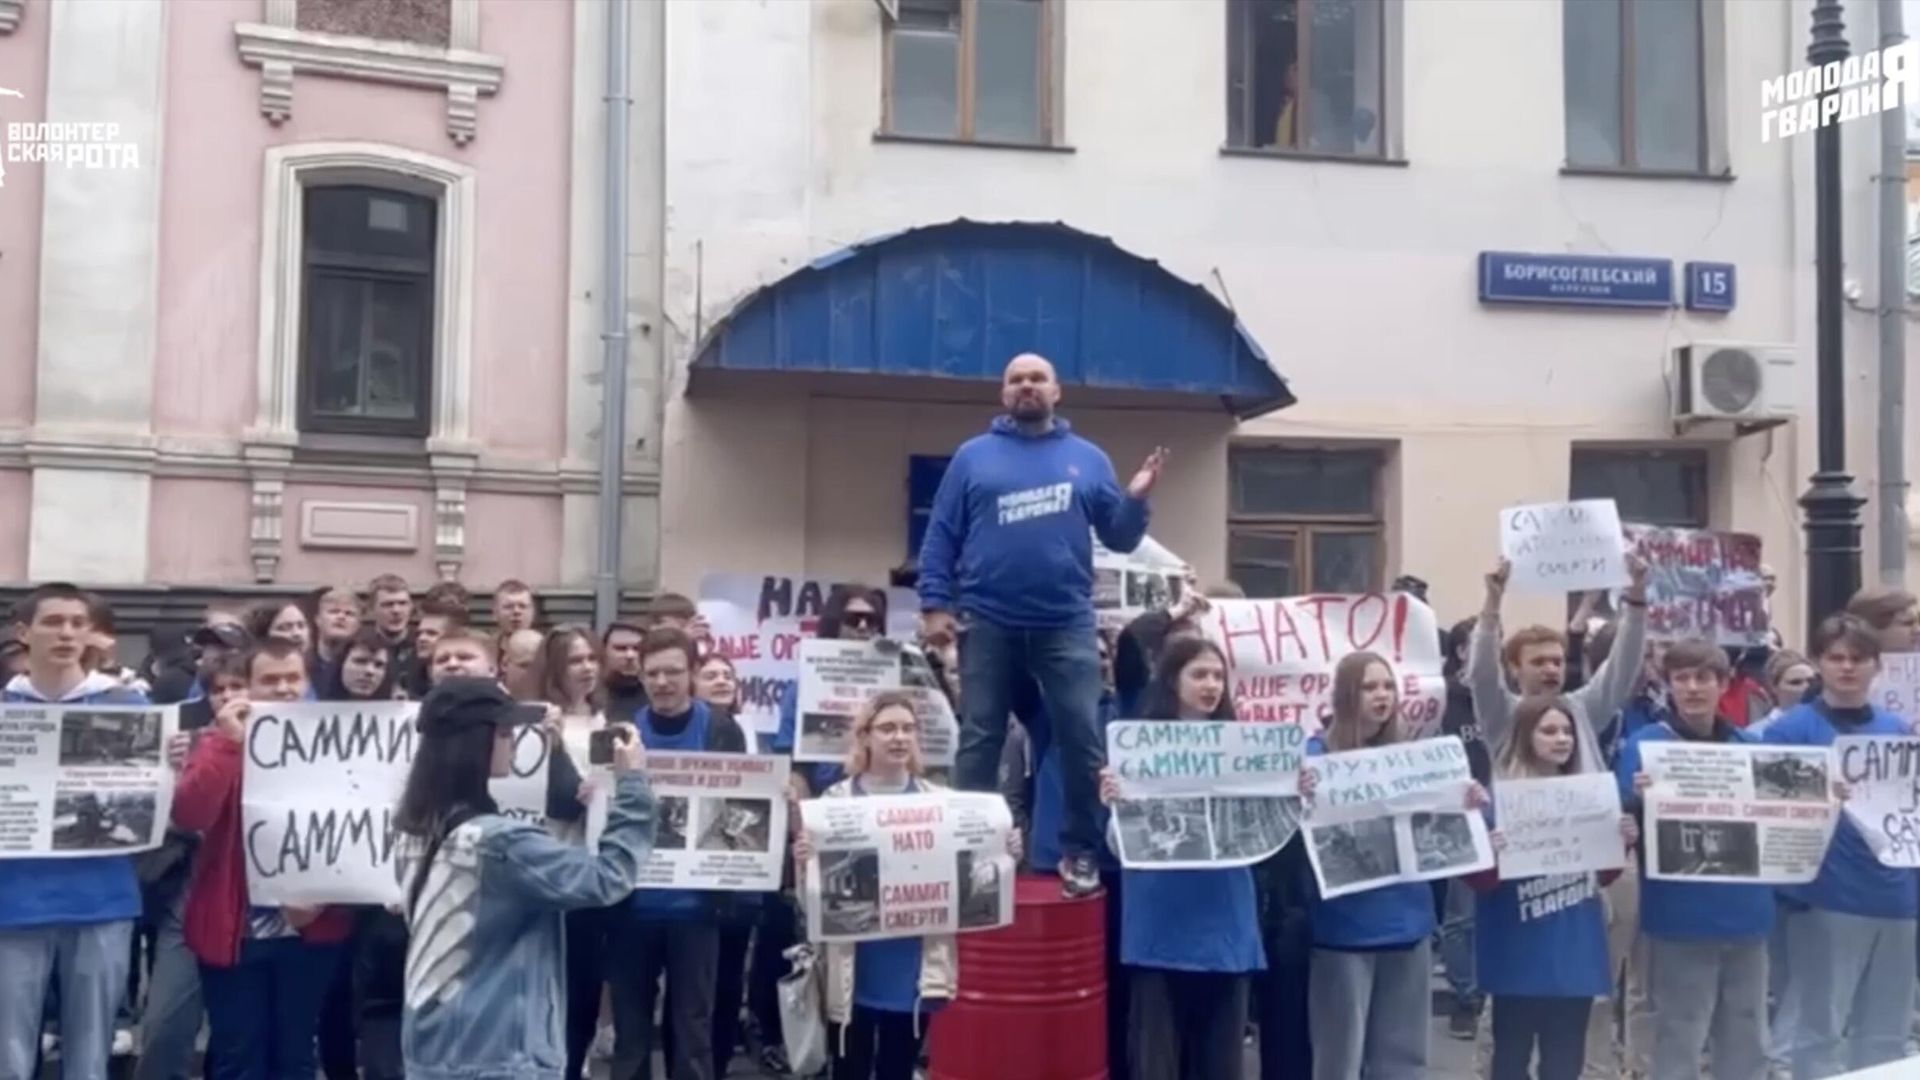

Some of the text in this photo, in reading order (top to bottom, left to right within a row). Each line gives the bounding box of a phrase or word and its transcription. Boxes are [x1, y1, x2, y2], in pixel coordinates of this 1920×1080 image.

[1504, 263, 1657, 284] БОРИСОГЛЕБСКИЙ
[1701, 271, 1727, 295] 15
[1219, 594, 1409, 667] НАТО!
[250, 712, 412, 769] САММИ
[1116, 724, 1303, 750] САММИТ НАТО
[1120, 750, 1225, 778] САММИТ
[876, 805, 943, 827] САММИТ
[249, 808, 396, 877] САММИ
[893, 829, 934, 852] НАТО
[881, 881, 950, 904] САММИТ
[884, 906, 949, 929] СМЕРТИ
